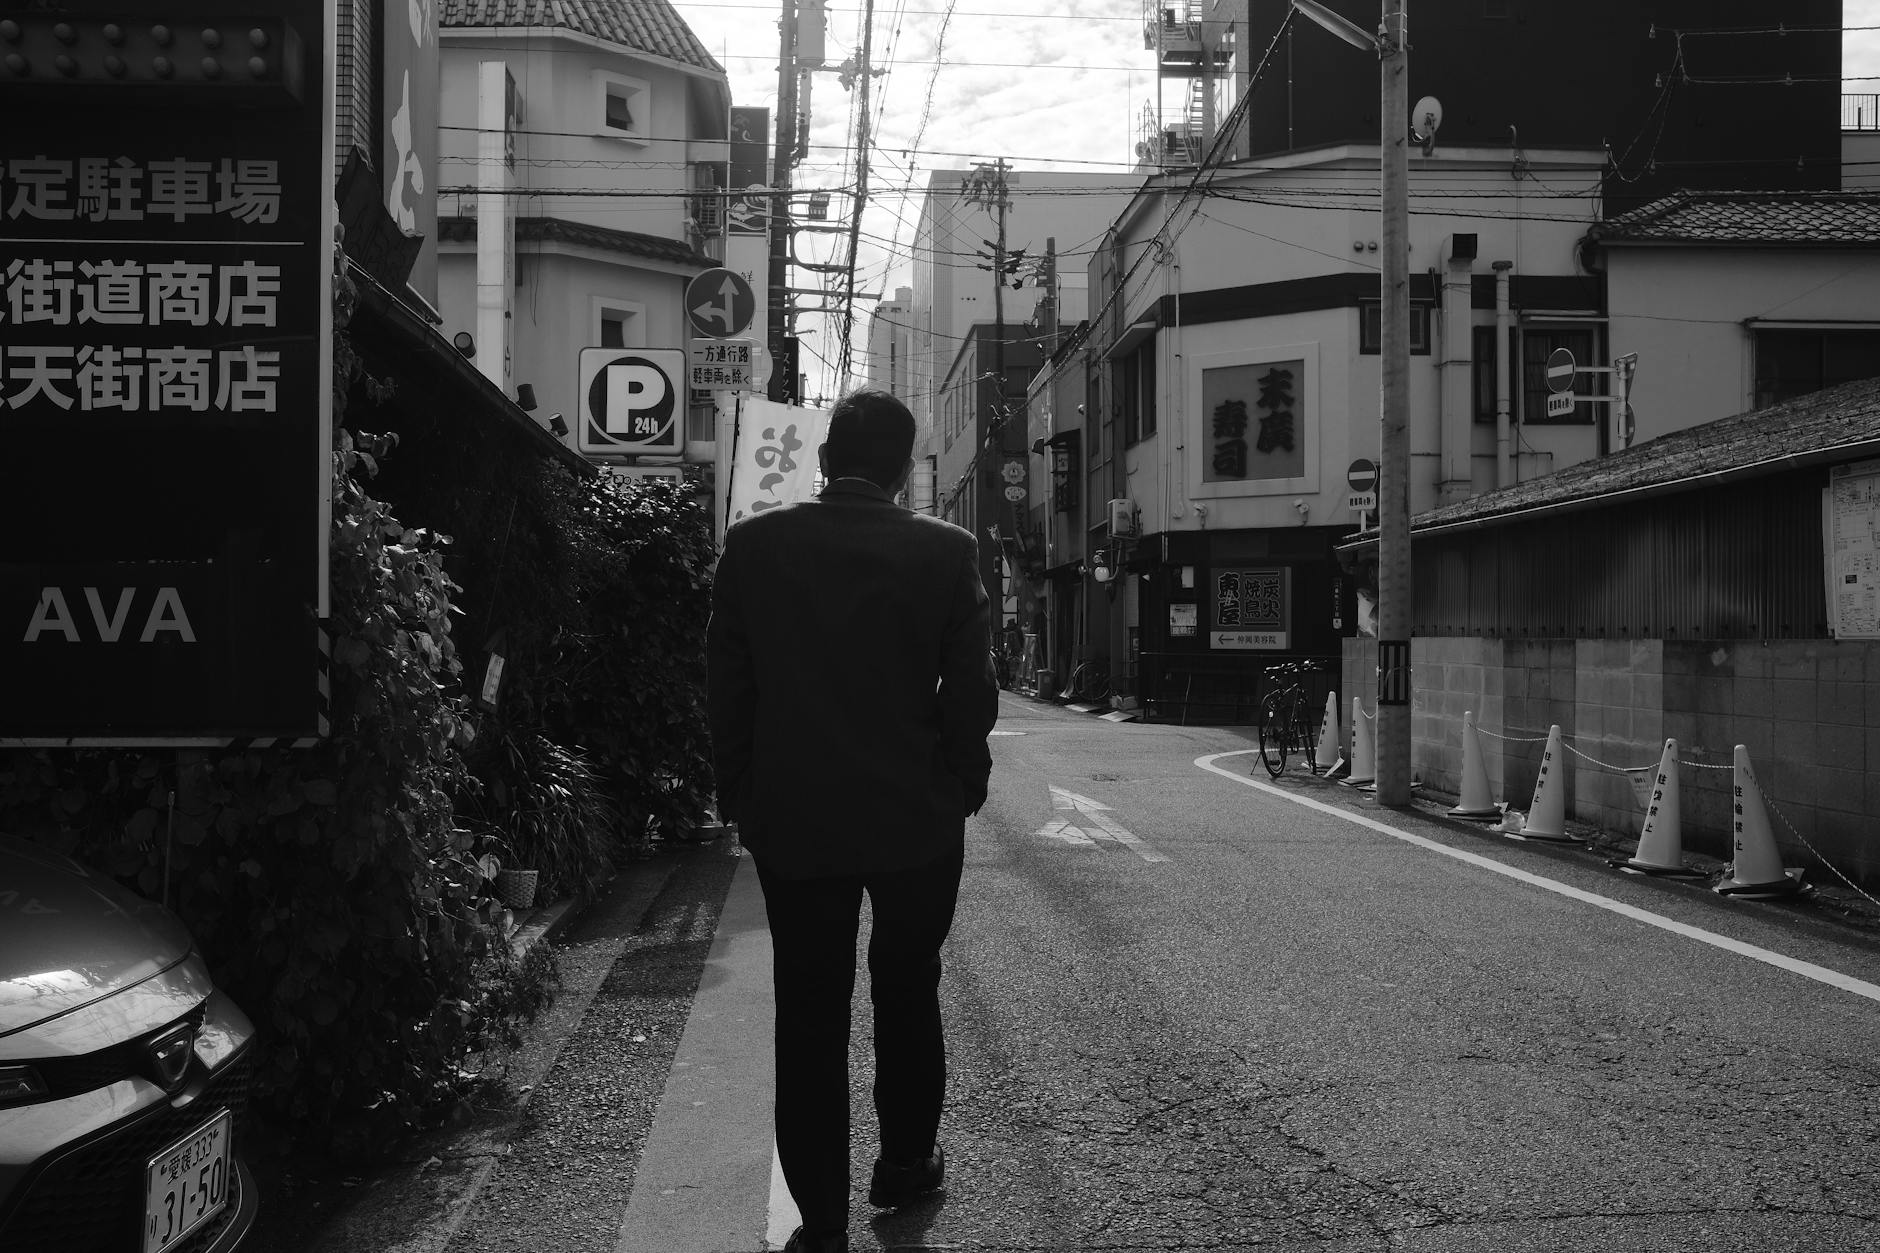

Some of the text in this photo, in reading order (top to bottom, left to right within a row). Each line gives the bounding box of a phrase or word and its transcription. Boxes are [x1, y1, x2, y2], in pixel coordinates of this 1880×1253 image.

[0, 154, 282, 224] 定駐車場
[0, 258, 281, 327] 街道商店
[0, 344, 281, 412] 天街商店
[693, 345, 749, 363] 一方通行路
[693, 367, 751, 385] 軽車両を除く
[606, 364, 666, 434] P
[634, 416, 659, 434] 24h
[23, 585, 197, 642] AVA
[168, 1131, 213, 1185] 愛媛 333
[161, 1156, 223, 1244] 31-50
